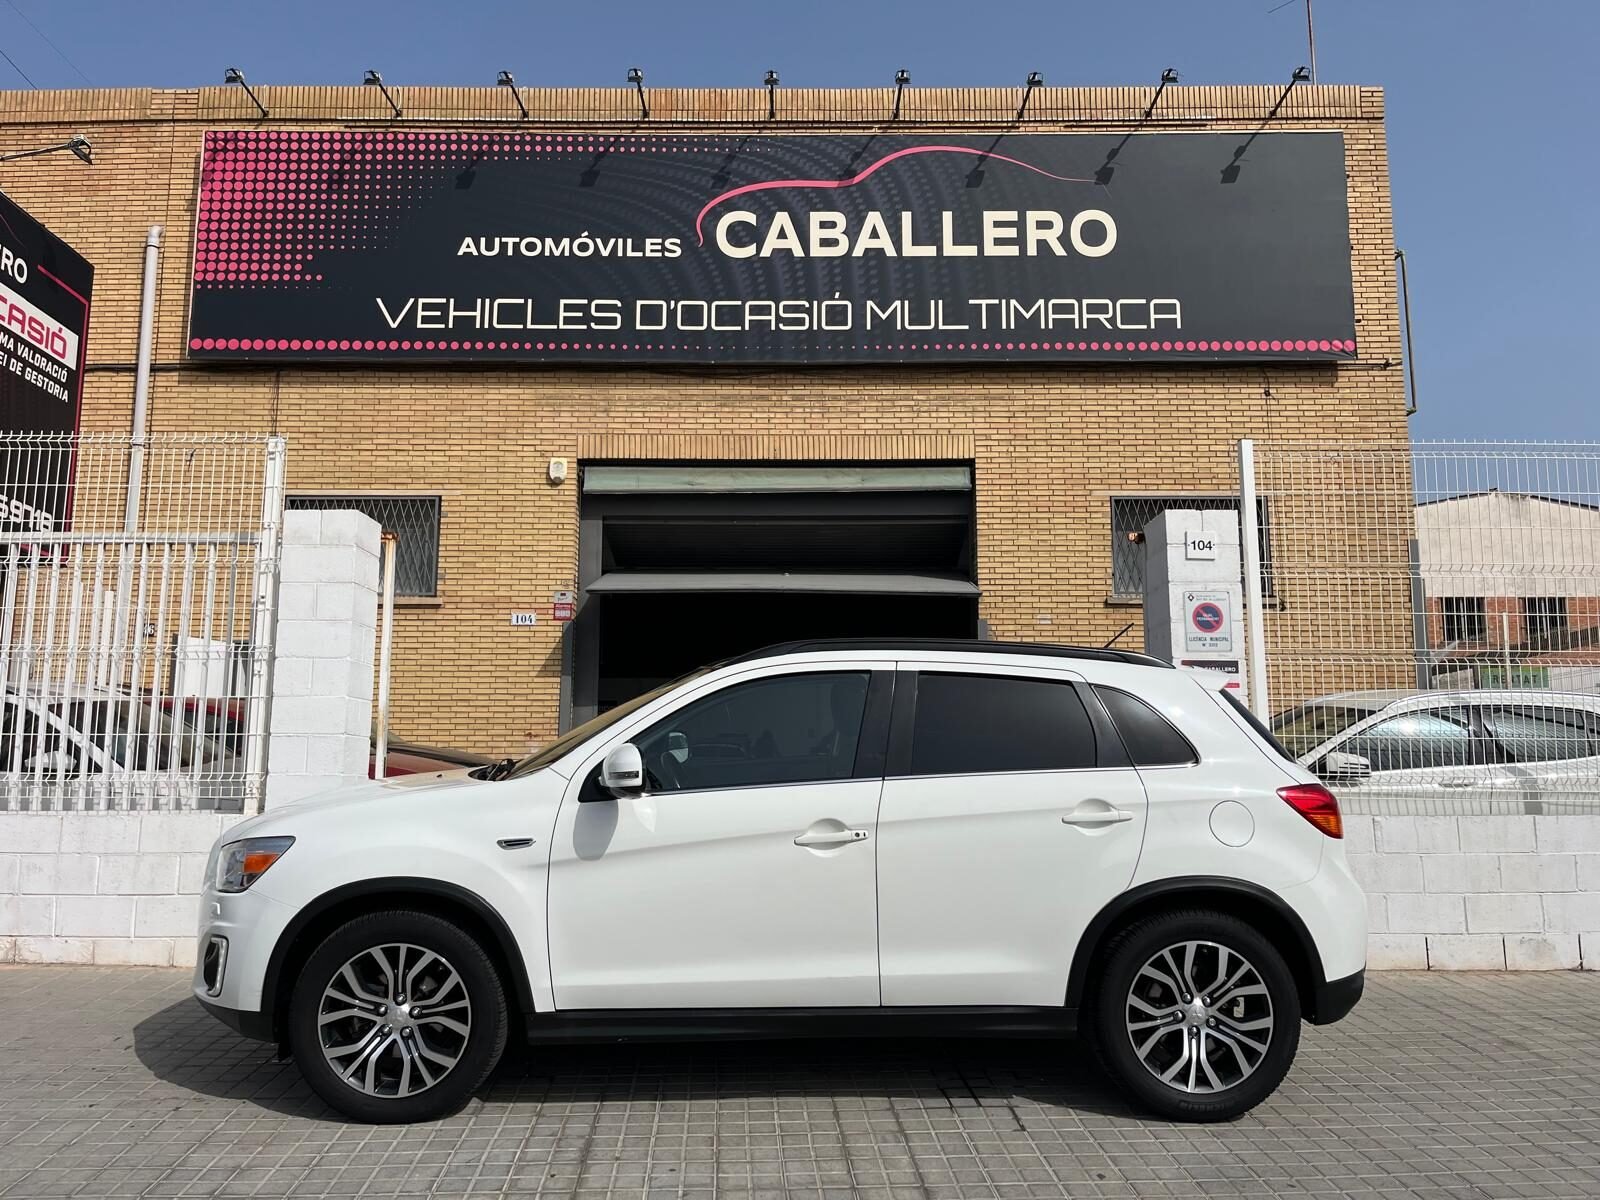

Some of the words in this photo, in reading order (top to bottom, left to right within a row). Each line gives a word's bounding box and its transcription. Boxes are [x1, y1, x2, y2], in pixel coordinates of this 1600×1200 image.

[457, 231, 682, 258] AUTOMÓVILES
[715, 209, 1118, 258] CABALLERO
[0, 244, 28, 284] RO
[376, 297, 622, 330] VEHICLES
[635, 291, 853, 331] D'OCASIÓ
[866, 298, 1182, 331] MULTIMARCA
[9, 358, 24, 375] DE
[25, 367, 69, 403] GESTORIA
[17, 342, 68, 383] VALORACIÓ
[1191, 540, 1212, 551] 104
[516, 615, 532, 623] 104
